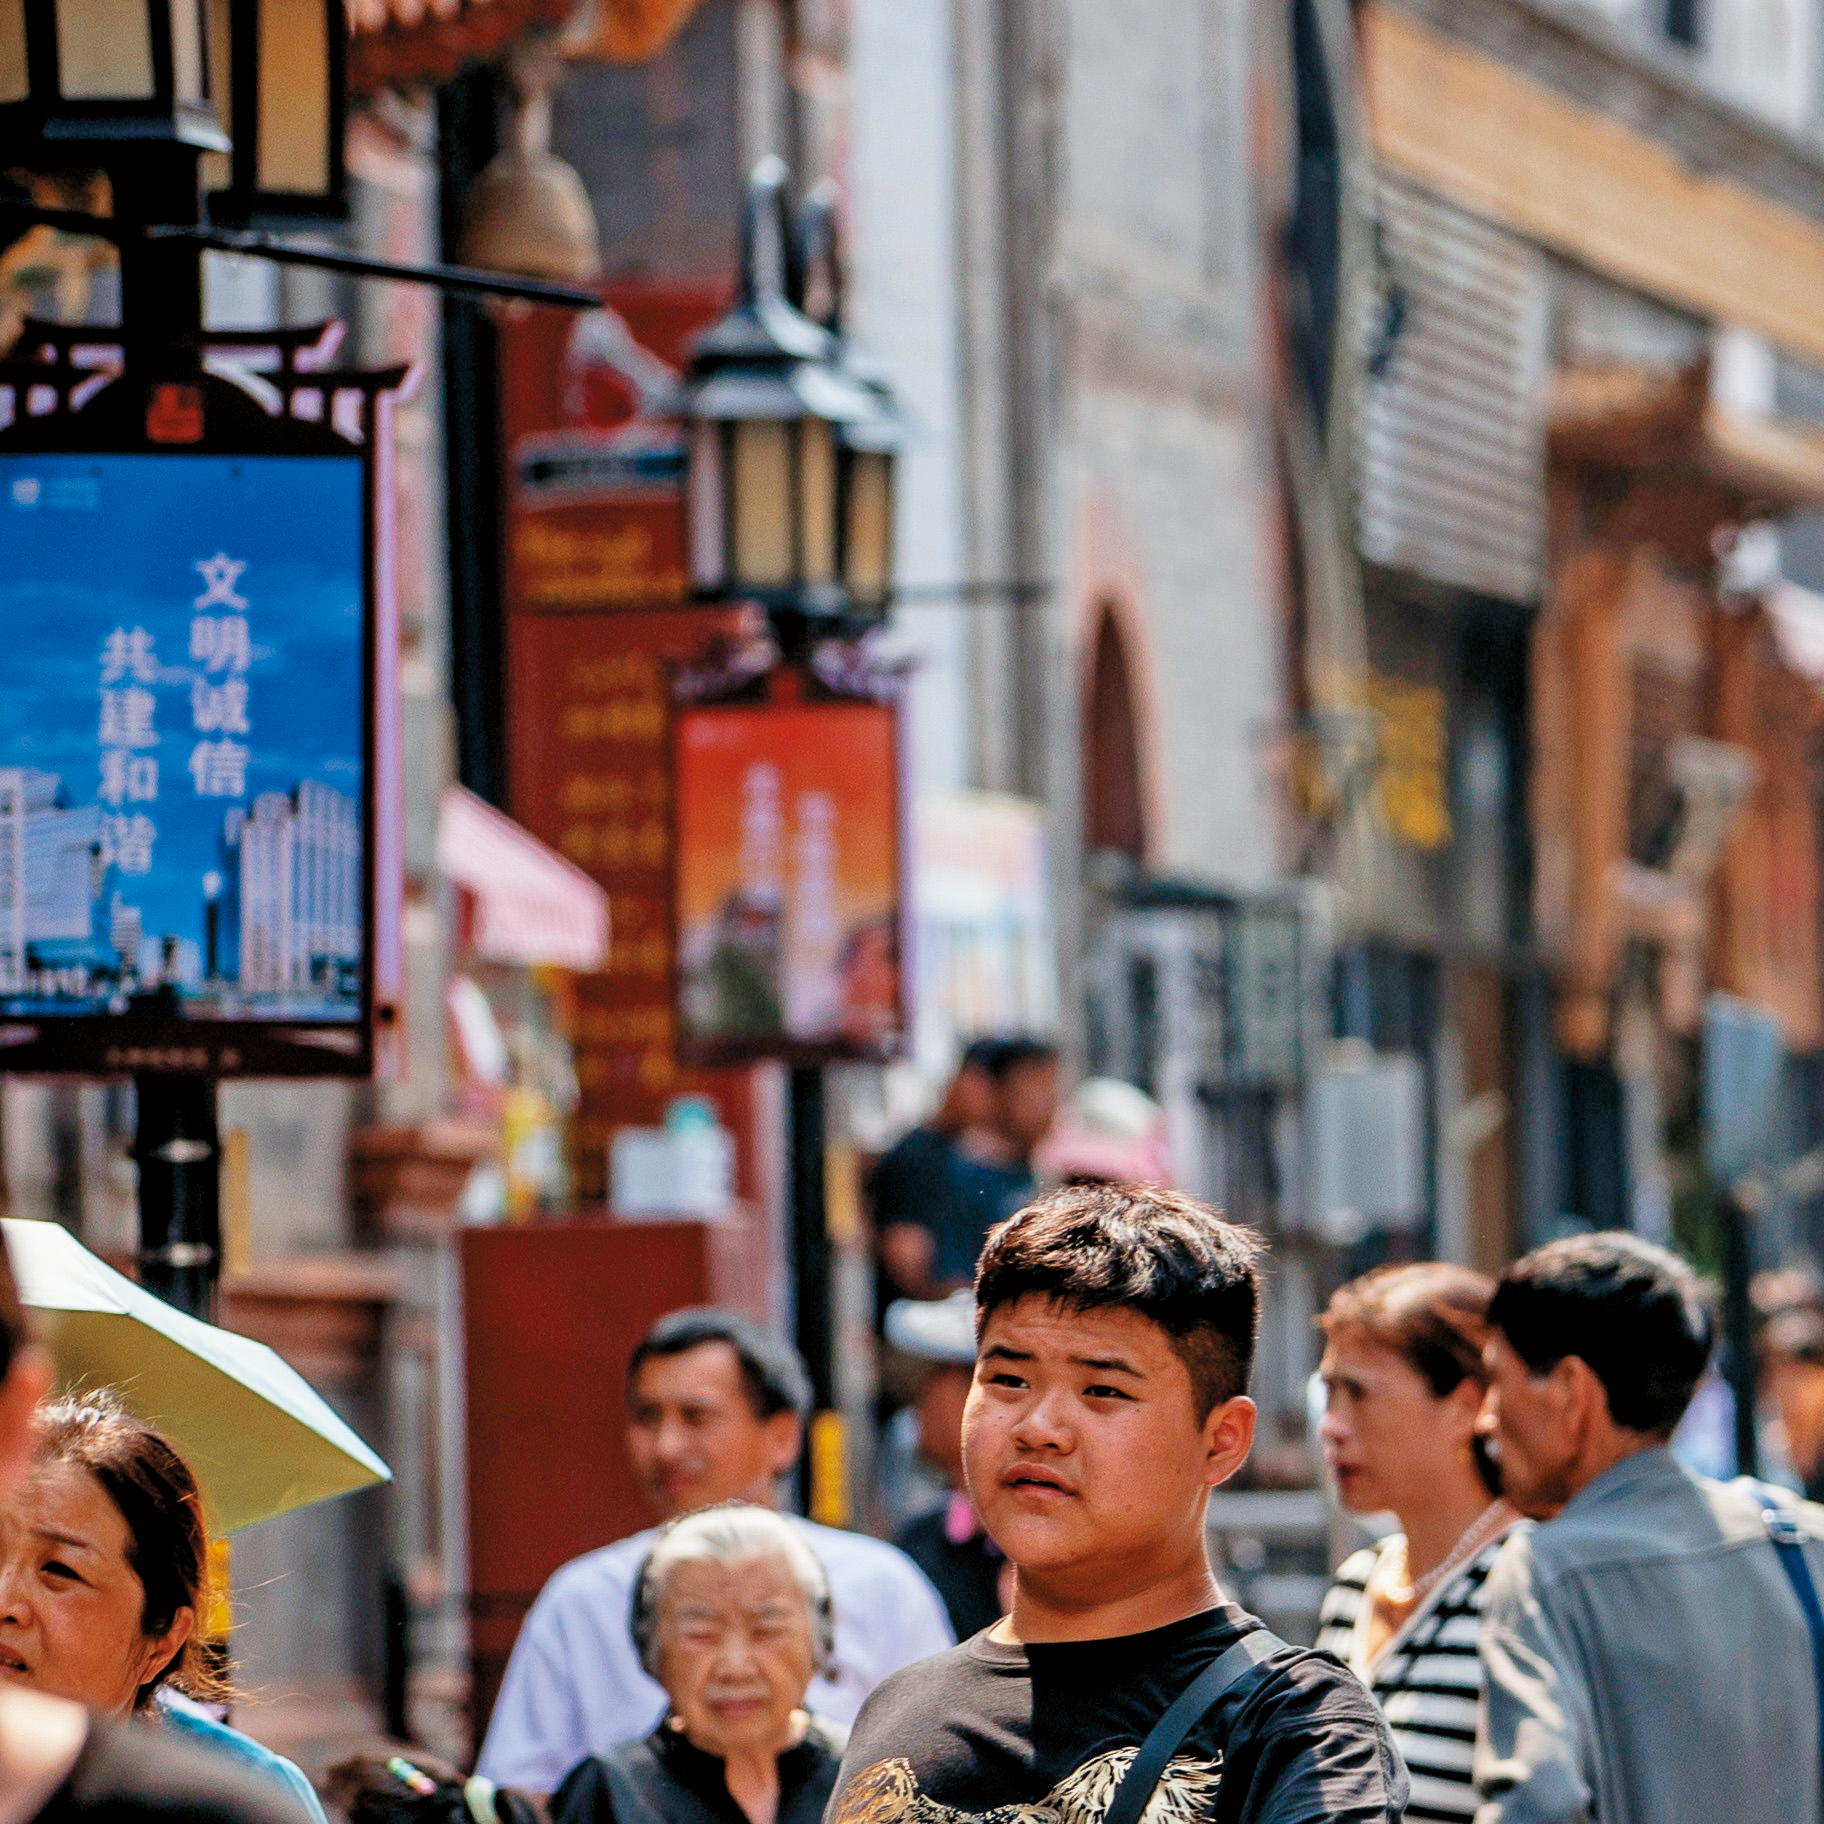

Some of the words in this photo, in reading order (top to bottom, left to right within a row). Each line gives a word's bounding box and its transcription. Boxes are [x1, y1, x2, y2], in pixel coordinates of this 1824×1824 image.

[98, 625, 160, 877] 共建和谐
[189, 551, 251, 798] 文明诚信
